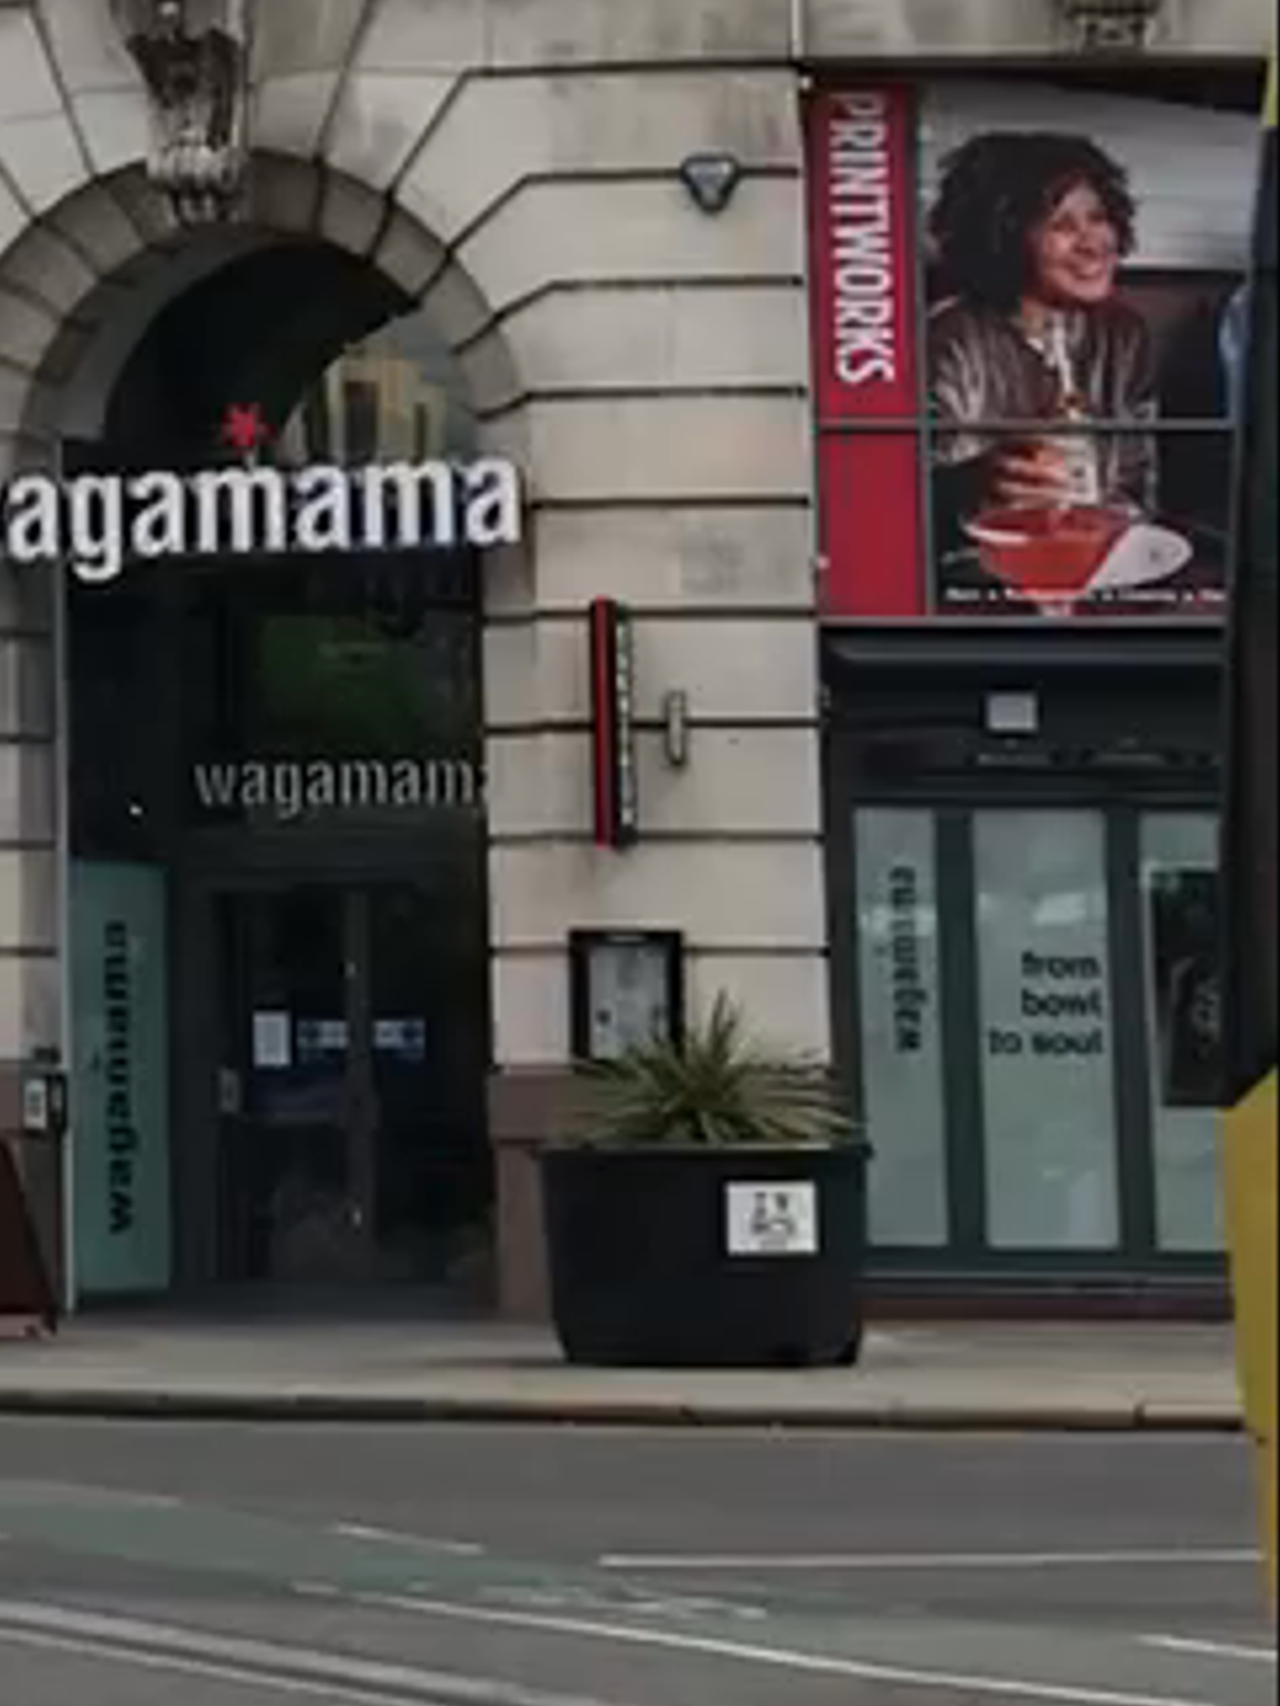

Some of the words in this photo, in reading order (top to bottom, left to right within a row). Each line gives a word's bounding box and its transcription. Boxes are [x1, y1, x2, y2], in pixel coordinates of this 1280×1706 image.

[830, 92, 895, 384] PRINTWORKS
[890, 864, 928, 1054] wagamama
[1021, 950, 1101, 978] from
[1021, 988, 1102, 1017] bowl
[104, 919, 137, 1235] wagamama
[989, 1028, 1022, 1055] to
[1032, 1028, 1102, 1055] soul
